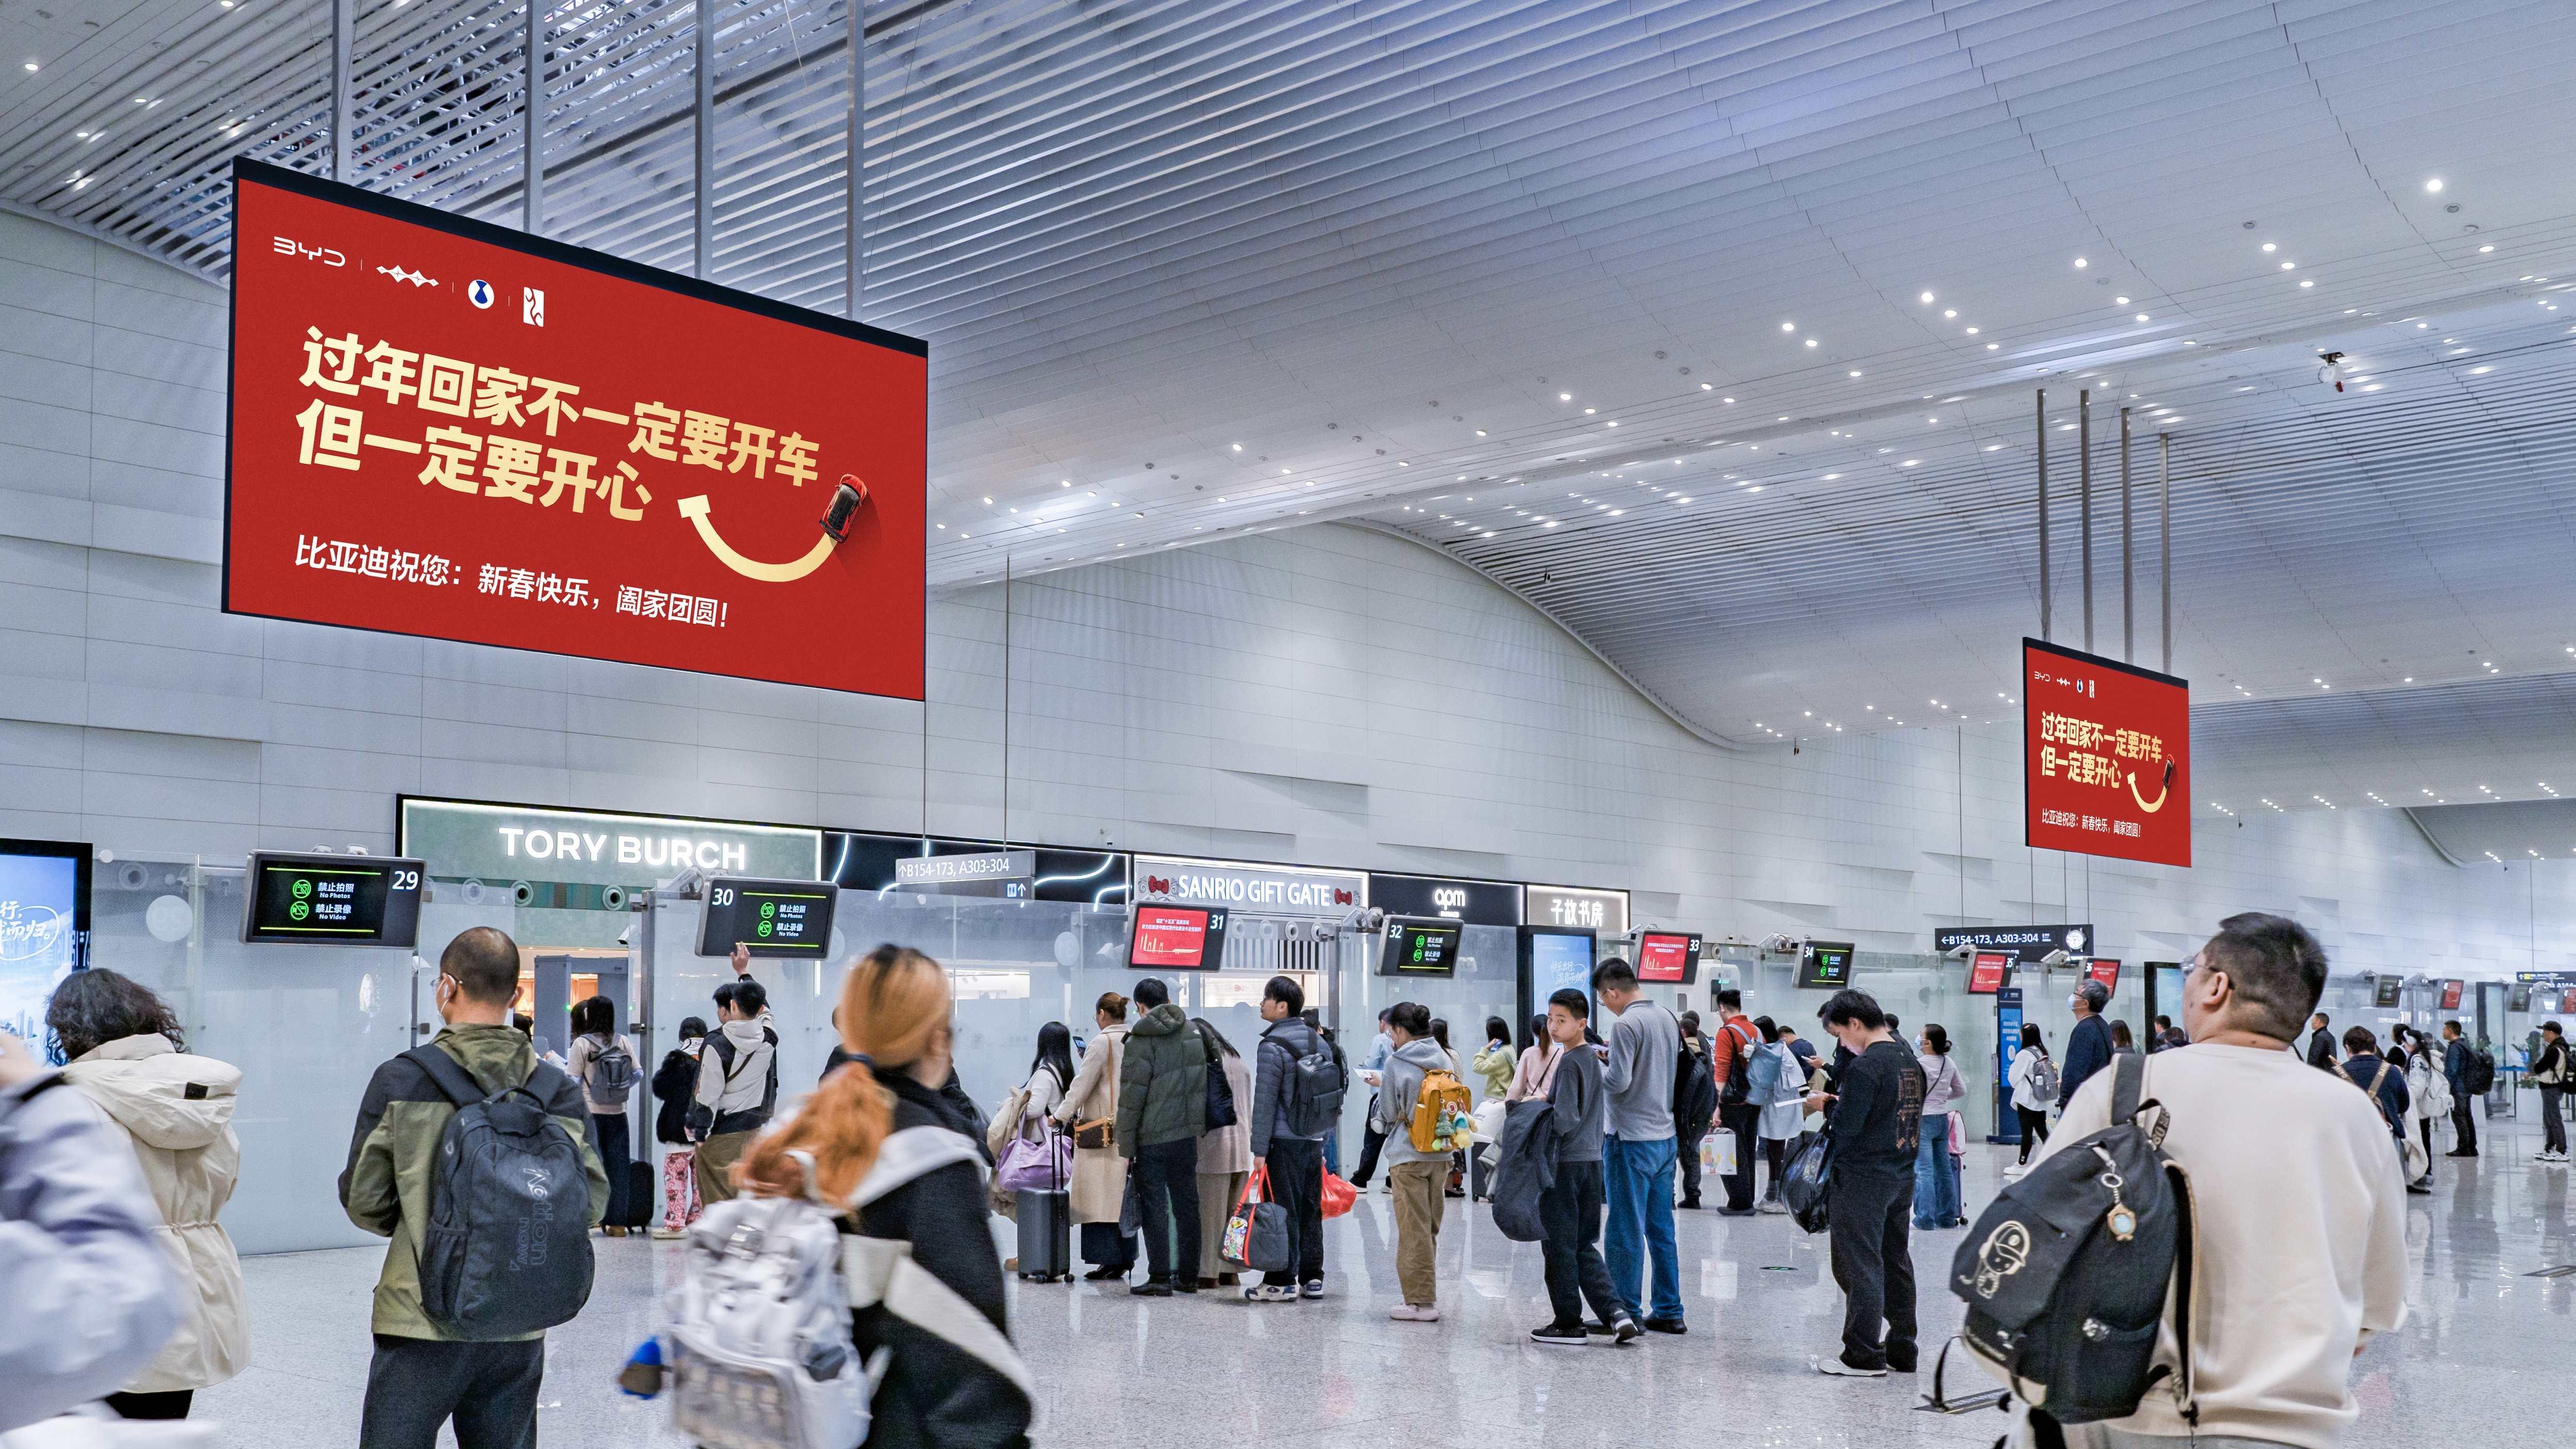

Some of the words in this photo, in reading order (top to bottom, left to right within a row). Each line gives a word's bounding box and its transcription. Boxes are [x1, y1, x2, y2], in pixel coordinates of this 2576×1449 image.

[274, 236, 345, 267] BYD
[299, 325, 820, 487] 过年回家不一定要开车
[296, 399, 652, 522] 但一定要开心
[2034, 671, 2050, 682] BYD
[2041, 711, 2162, 764] 过年回家不一定要开车
[2040, 744, 2121, 789] 但一定要开心
[499, 827, 608, 861] TORY
[618, 836, 745, 870] BURCH
[907, 861, 957, 877] B154-173,
[958, 858, 1010, 874] A303-304
[317, 881, 355, 893] 禁止拍照
[392, 871, 419, 890] 29
[712, 888, 734, 906] 30
[1178, 875, 1245, 901] SANRIO
[1247, 880, 1285, 903] GIFT
[1287, 883, 1330, 906] GATE
[315, 904, 352, 914] 禁止录像
[779, 904, 806, 914] 禁止拍照
[1550, 899, 1603, 927] 子故书房
[776, 922, 803, 932] 禁止录像
[1210, 915, 1224, 930] 31
[1389, 924, 1403, 939] 32
[1949, 934, 1993, 946] B154-173,
[1994, 933, 2039, 943] A303-304
[1689, 939, 1700, 951] 33
[1804, 947, 1814, 958] 34
[2006, 957, 2014, 968] 35
